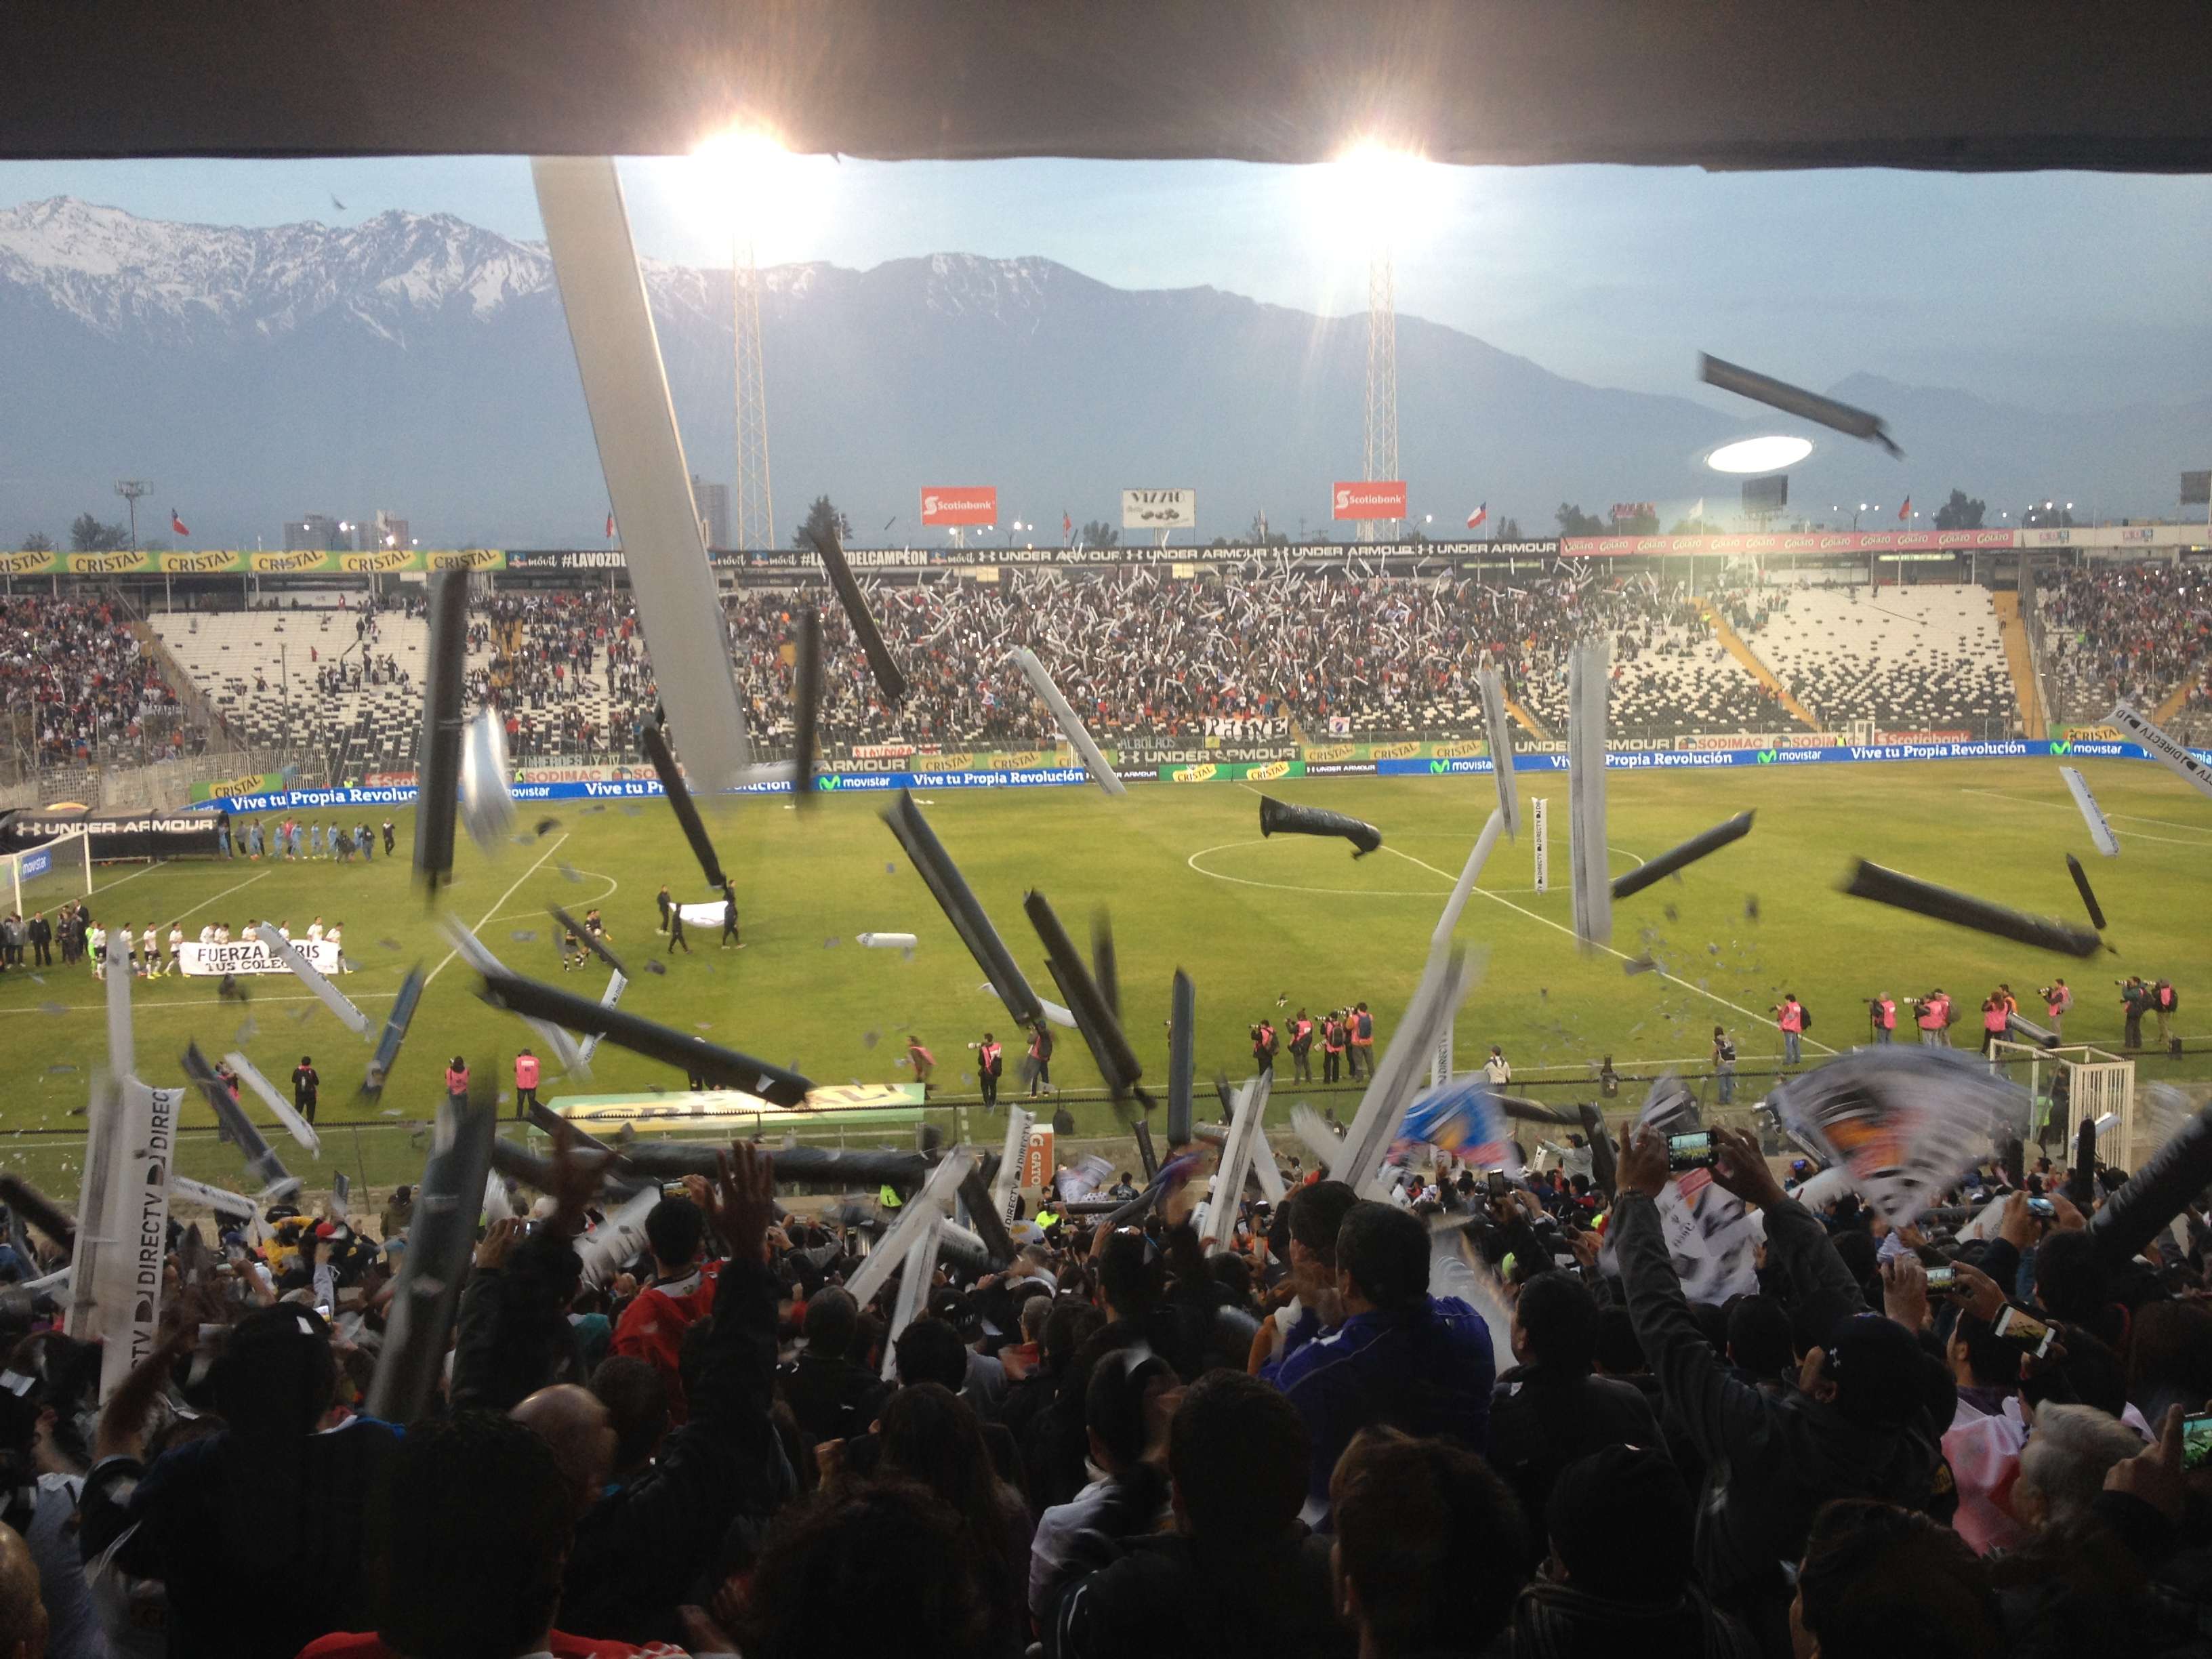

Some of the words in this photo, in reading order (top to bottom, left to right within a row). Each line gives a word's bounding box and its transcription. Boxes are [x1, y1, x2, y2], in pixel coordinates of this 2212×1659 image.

[938, 500, 991, 510] Scotiabank
[1349, 494, 1401, 505] Scotiabank
[999, 552, 1052, 562] UNDER
[1147, 550, 1197, 560] UNDER
[1202, 548, 1268, 559] ARMOUR
[1292, 546, 1343, 556] UNDER
[1349, 545, 1414, 555] ARMOUR
[1437, 544, 1488, 554] UNDER
[1492, 543, 1557, 553] ARMOUR
[0, 550, 51, 573] RISTAL
[75, 550, 144, 573] CRISTAL
[167, 550, 235, 572] CRISTAL
[258, 549, 323, 572] CRISTAL
[347, 548, 411, 572] CRISTAL
[433, 548, 497, 570] CRISTAL
[1515, 741, 1570, 753] UNDE
[1698, 737, 1763, 750] SODIMAC
[1793, 736, 1860, 748] SODIMC
[1888, 733, 1969, 745] Scotiabank
[2139, 726, 2182, 760] DIRECTV
[1144, 750, 1210, 763] UNDER
[1309, 743, 1354, 761] CRISTAL
[1374, 743, 1417, 760] CRISTAL
[1437, 741, 1480, 758] CRISTAL
[1779, 750, 1822, 760] movistar
[1851, 747, 1881, 760] Vive
[1885, 747, 1900, 758] tu
[1904, 744, 1948, 759] Propia
[1951, 741, 2026, 755] Revolución
[2074, 743, 2123, 754] movistar
[819, 758, 906, 772] ARMOUR
[926, 754, 971, 772] CRISTAL
[993, 752, 1039, 769] CRISTAL
[1452, 760, 1494, 771] movista
[1605, 753, 1651, 769] Propia
[1654, 750, 1733, 766] Revolución
[526, 769, 602, 783] SODIMAC
[914, 773, 944, 786] Vive
[946, 774, 962, 785] tu
[964, 773, 1008, 787] Propia
[1010, 766, 1084, 783] Revolución
[1178, 766, 1214, 781] CRISTAL
[1251, 764, 1287, 781] CRISTAL
[215, 775, 262, 798] CRISTAL
[586, 782, 622, 796] Vive
[626, 781, 642, 794] tu
[843, 777, 890, 788] movistar
[231, 796, 268, 811] Vive
[271, 794, 287, 806] tu
[290, 791, 346, 806] Propia
[350, 787, 418, 803] Revoluc
[45, 821, 117, 835] UNDER
[123, 819, 213, 834] ARMOUR
[22, 855, 47, 875] movistar
[197, 945, 264, 962] FUERZA
[206, 962, 236, 972] TUS
[241, 959, 289, 970] COLE
[149, 1086, 169, 1151] DIREC
[1018, 1125, 1031, 1164] DIRECTV
[1031, 1151, 1042, 1187] GATO
[1005, 1184, 1019, 1227] DIRECTV
[140, 1191, 162, 1286] DIRECTV
